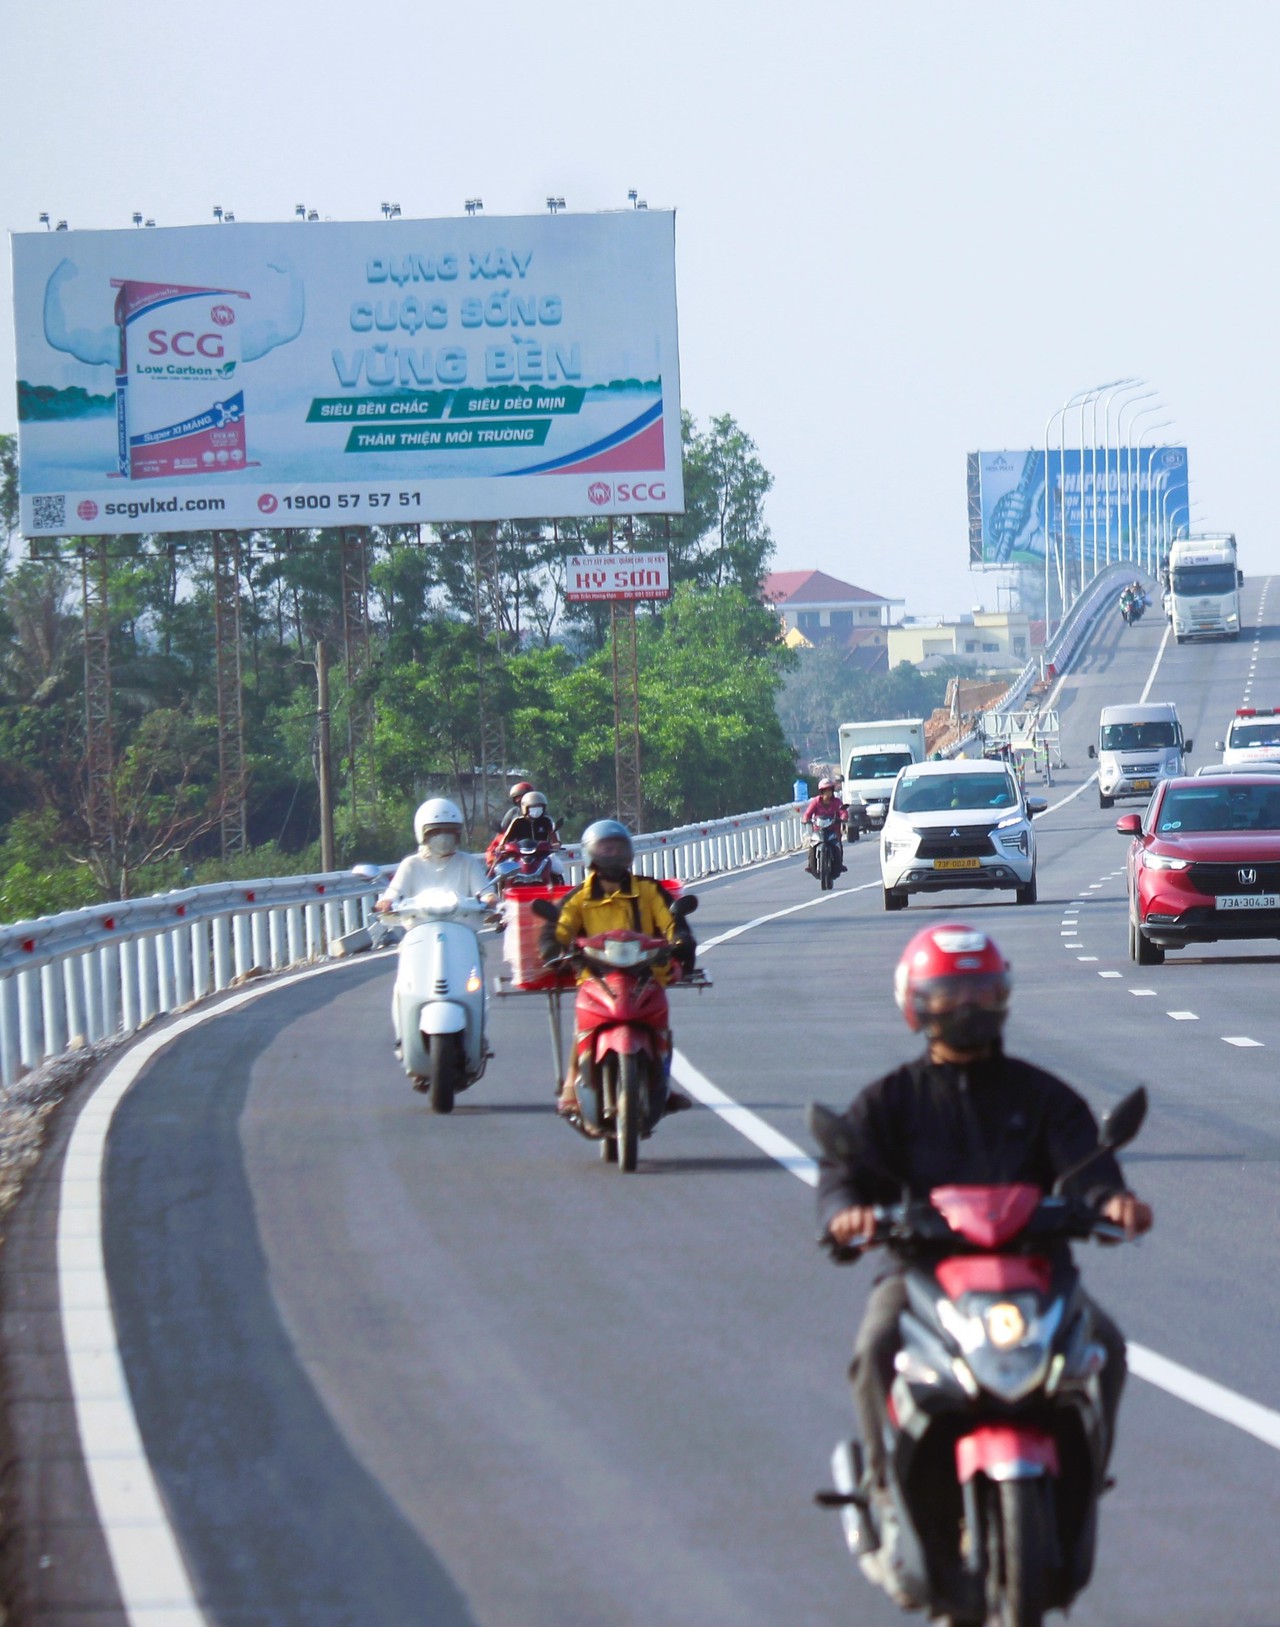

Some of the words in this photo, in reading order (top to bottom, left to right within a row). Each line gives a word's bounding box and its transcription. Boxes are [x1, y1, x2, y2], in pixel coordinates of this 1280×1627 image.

[469, 248, 533, 280] XÂY
[350, 297, 448, 336] CUỘC
[461, 289, 562, 328] SỐNG
[148, 330, 224, 358] SCG
[332, 343, 467, 387] VỮNG
[485, 333, 582, 382] BỀN
[136, 364, 163, 374] Low
[166, 365, 212, 375] Carbon
[321, 402, 352, 416] SIÊU
[357, 400, 387, 415] BỀN
[468, 397, 501, 411] SIÊU
[536, 396, 565, 410] MỊN
[144, 430, 170, 442] Super
[358, 433, 396, 446] THÂN
[400, 431, 441, 446] THIỆN
[445, 430, 473, 442] MÔI
[477, 428, 534, 442] TRƯỜNG
[283, 495, 331, 510] 1900
[338, 494, 360, 509] 57
[368, 493, 391, 507] 57
[399, 492, 421, 506] 51
[617, 483, 666, 501] SCG
[105, 497, 225, 518] scgvlxd.com
[576, 569, 606, 588] KỲ
[1221, 897, 1275, 908] 73A-304.38
